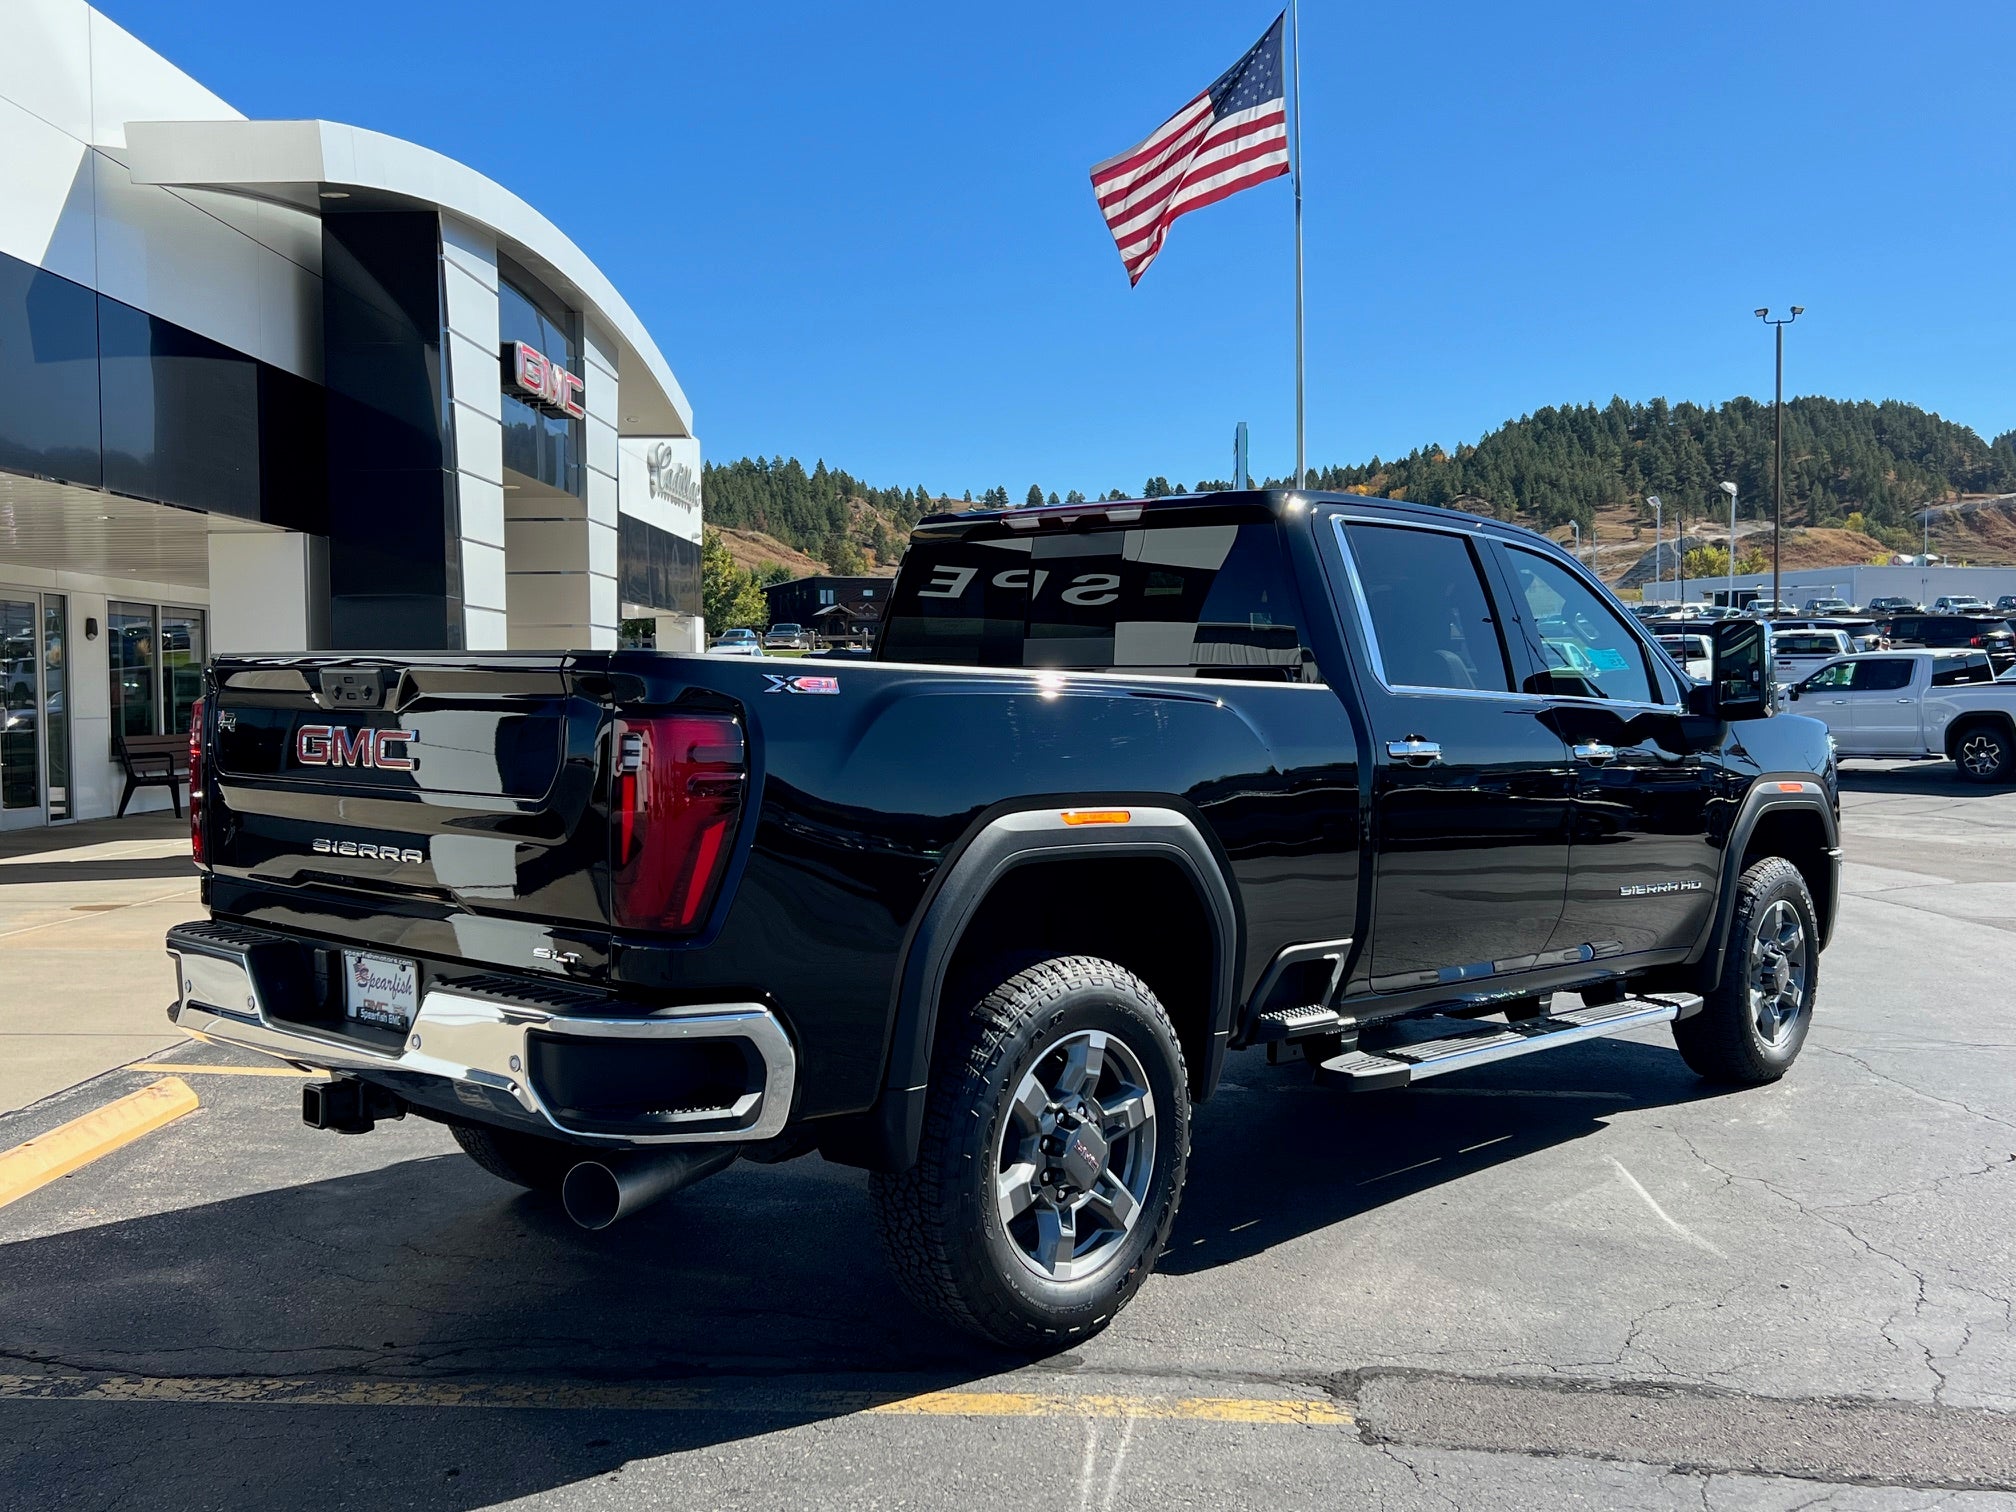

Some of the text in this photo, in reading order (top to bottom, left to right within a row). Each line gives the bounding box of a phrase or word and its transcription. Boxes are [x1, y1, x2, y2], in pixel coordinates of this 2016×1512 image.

[514, 340, 585, 421] GMC
[647, 441, 700, 514] Cadillac
[296, 724, 420, 771] GMC
[312, 838, 424, 864] SIERRA
[1620, 880, 1702, 896] SIERRA HD
[533, 947, 583, 964] SLT
[357, 967, 413, 1000] Spearfish
